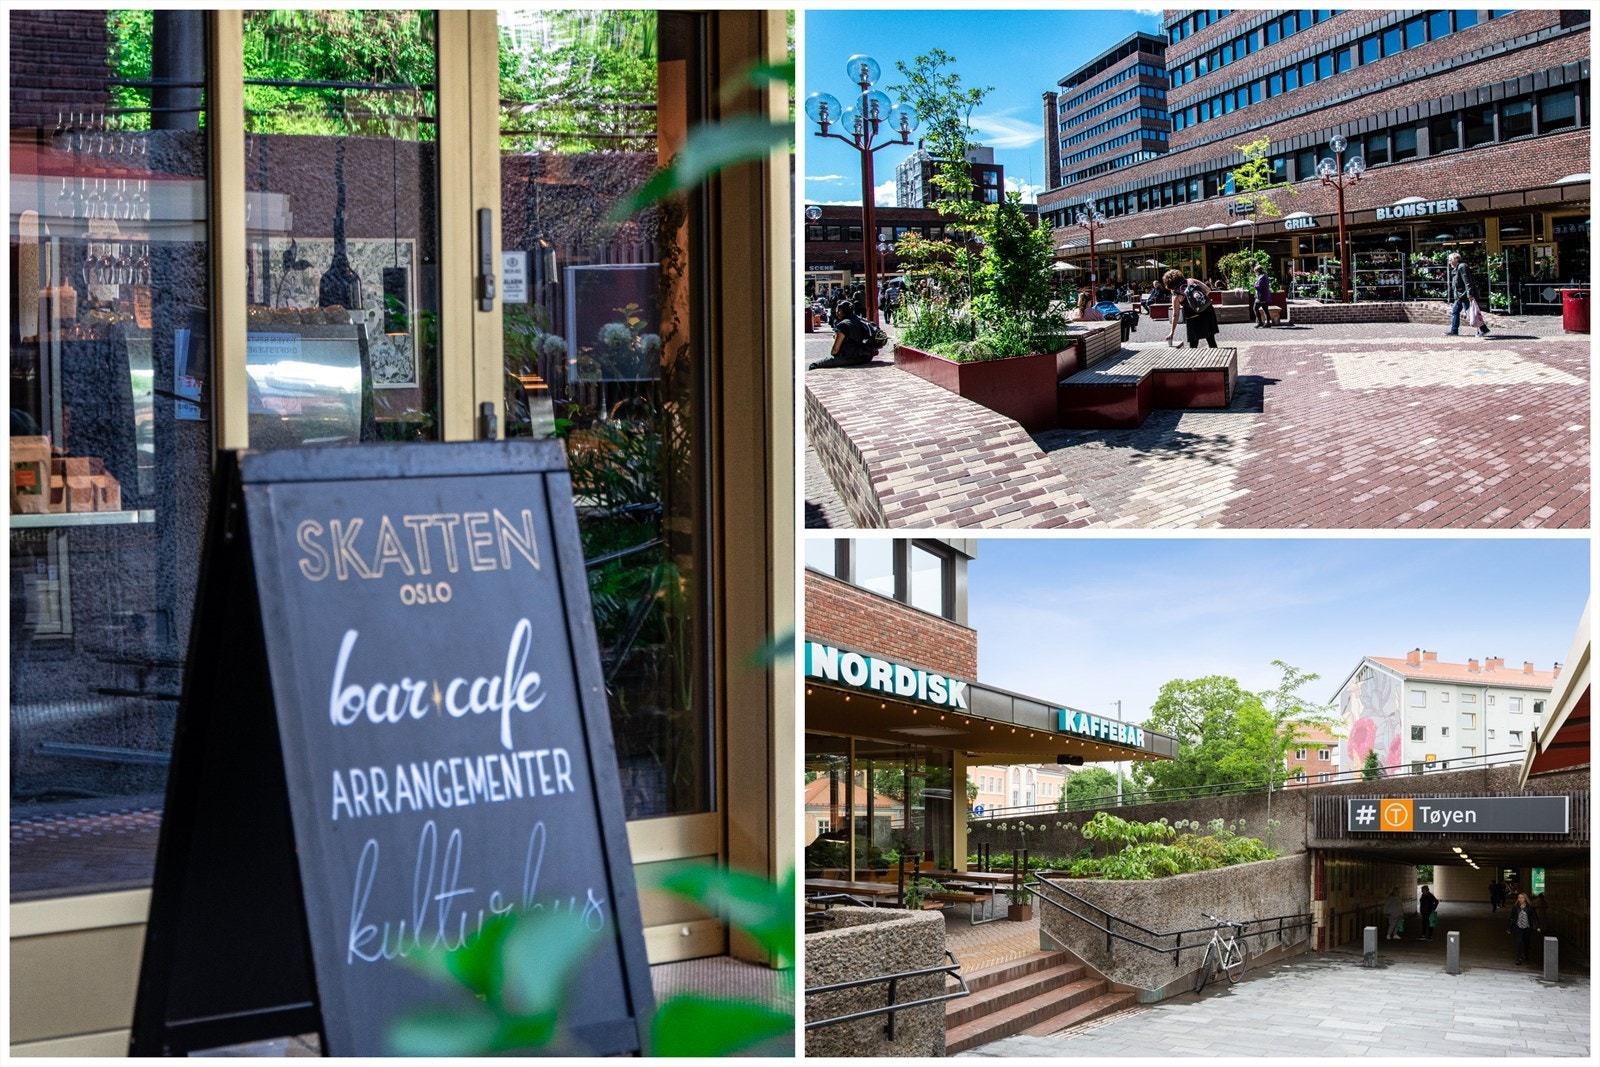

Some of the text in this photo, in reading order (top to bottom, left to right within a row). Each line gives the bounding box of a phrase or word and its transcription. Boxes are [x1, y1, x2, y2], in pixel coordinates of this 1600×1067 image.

[1285, 217, 1316, 230] GRILL
[1376, 199, 1459, 220] BLOMSTER
[297, 508, 541, 581] SKATTEN
[400, 581, 453, 606] OSLO
[330, 618, 546, 750] bar cafe
[809, 642, 969, 710] NORDISK
[1061, 708, 1146, 748] KAFFEBAR
[331, 746, 575, 821] ARRANGEMENTER
[1419, 806, 1477, 826] Tøyen
[347, 819, 606, 965] kultuhs
